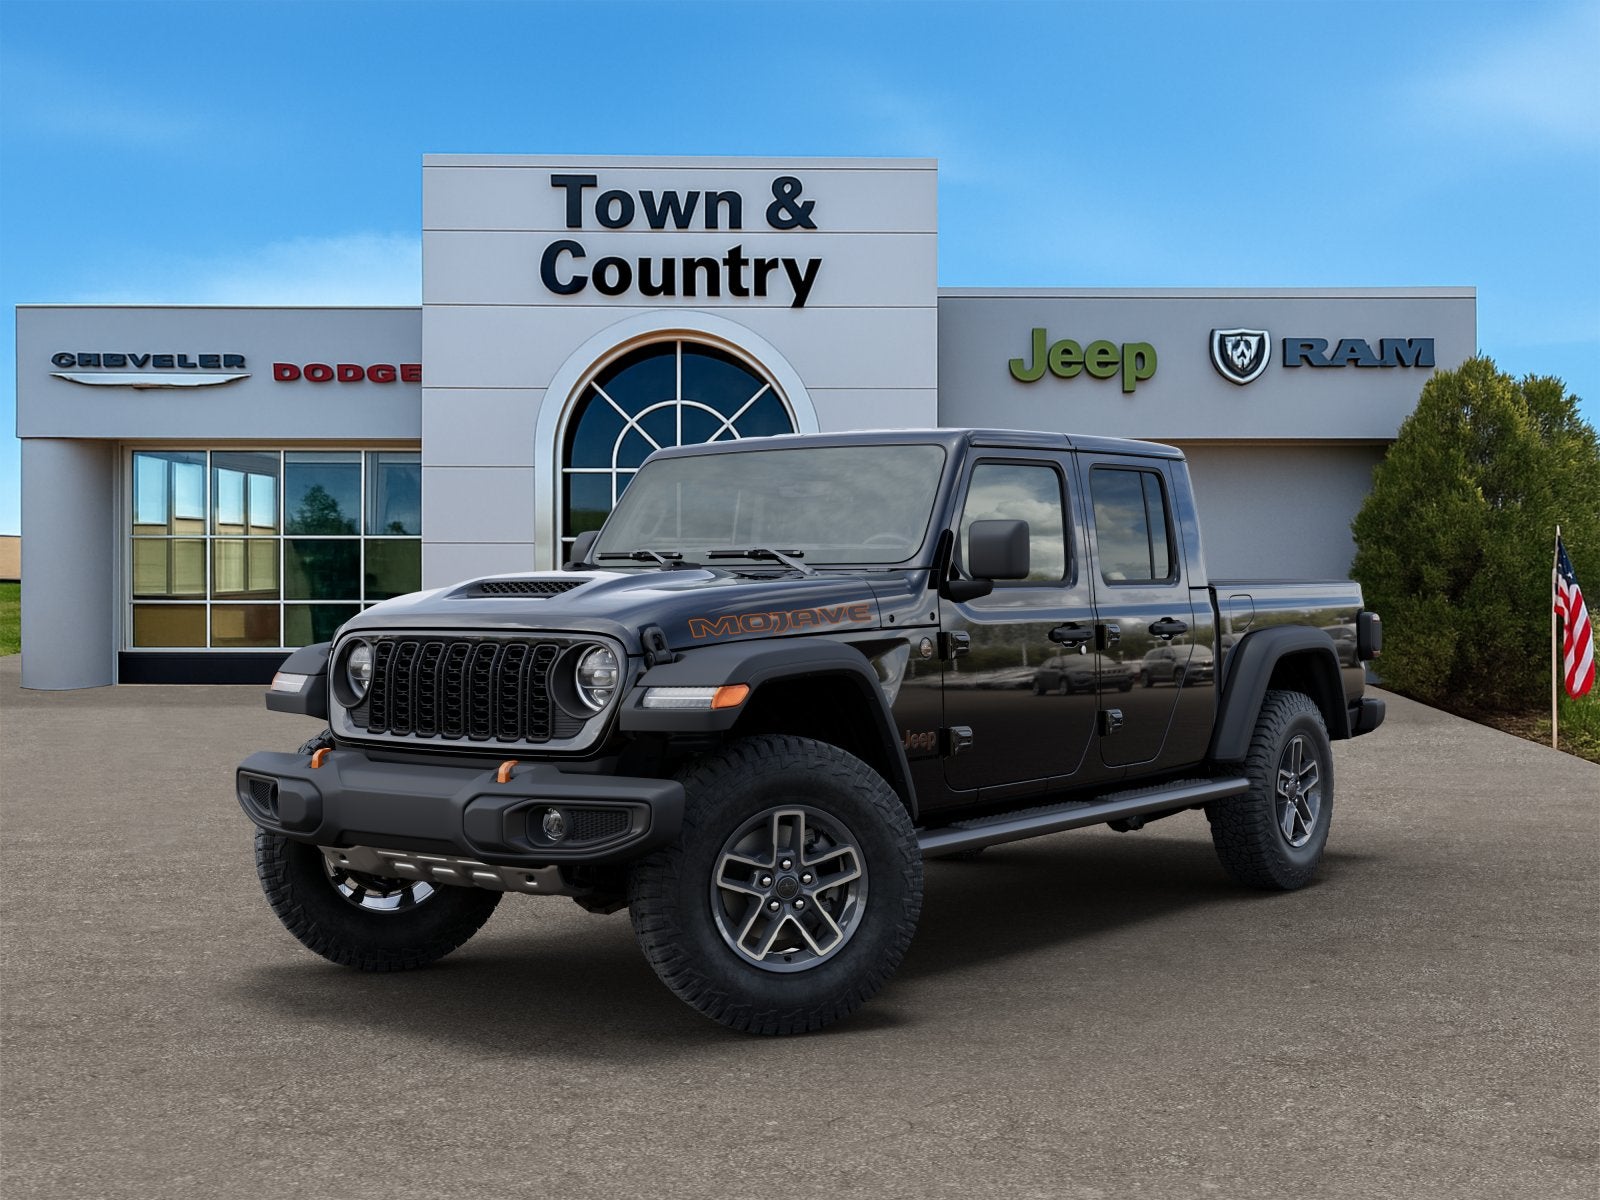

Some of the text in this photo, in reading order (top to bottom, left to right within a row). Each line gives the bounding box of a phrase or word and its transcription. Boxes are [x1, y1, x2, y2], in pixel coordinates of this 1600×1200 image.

[550, 174, 818, 229] Town &
[540, 240, 822, 308] Country
[1009, 328, 1157, 393] Jeep
[1282, 337, 1436, 368] RAM
[273, 363, 422, 383] DODGE
[688, 604, 872, 639] MOJAVE
[904, 730, 936, 751] Jeep
